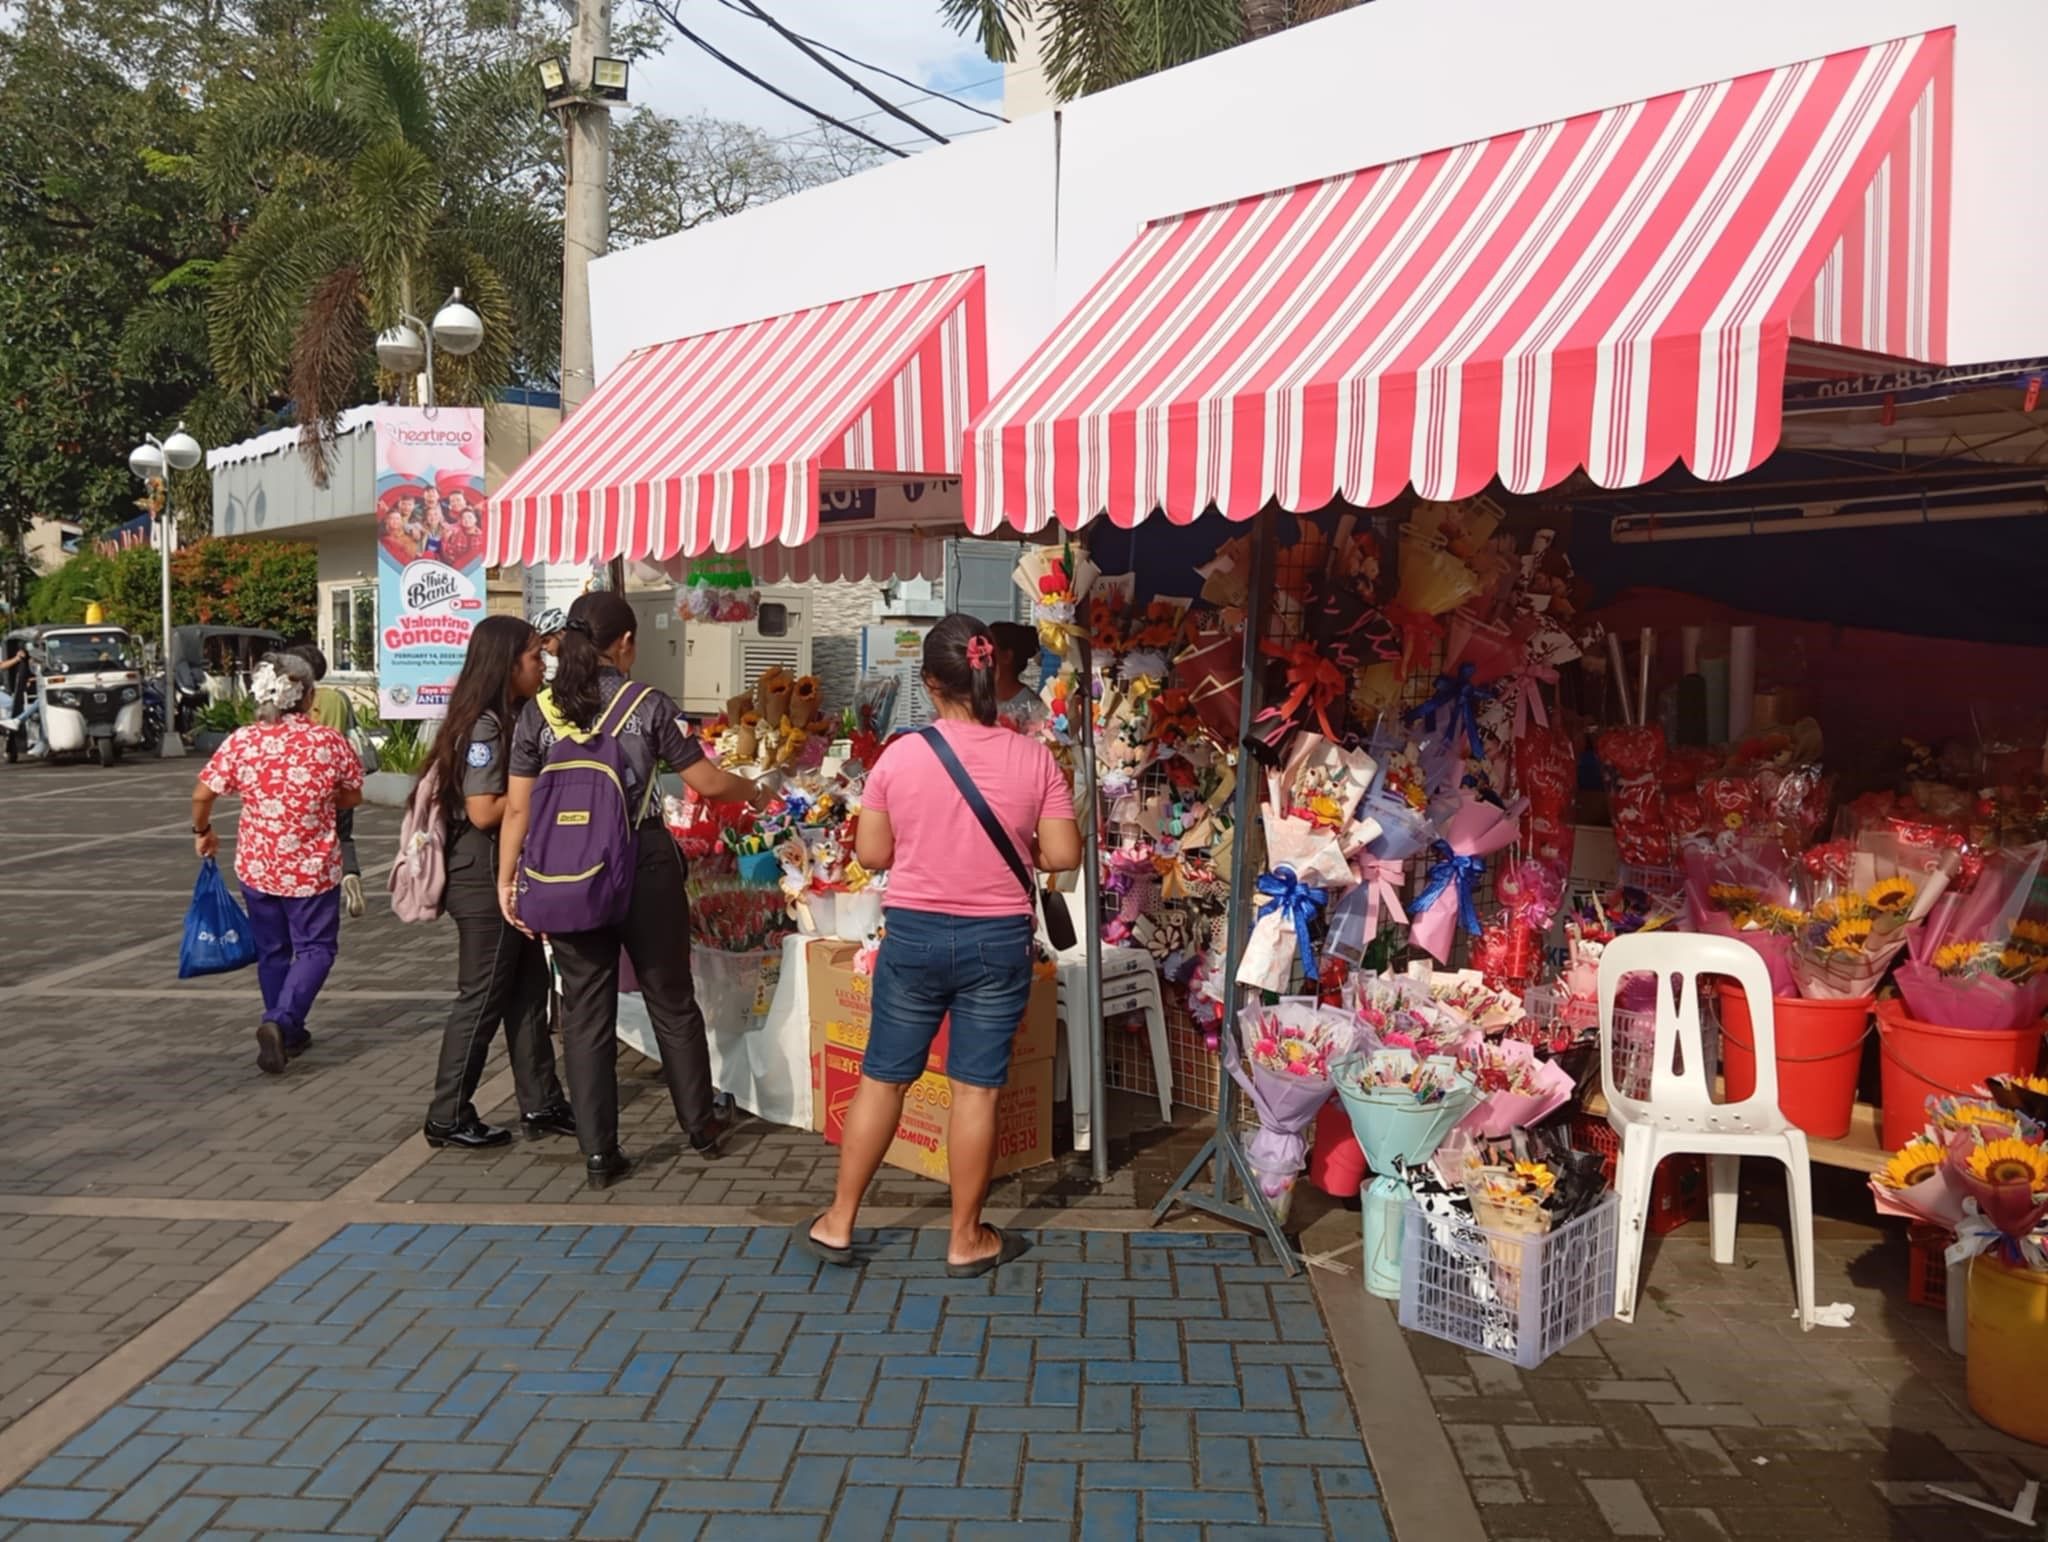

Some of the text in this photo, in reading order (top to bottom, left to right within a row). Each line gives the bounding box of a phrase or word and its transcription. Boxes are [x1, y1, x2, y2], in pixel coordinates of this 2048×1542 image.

[421, 570, 449, 588] This
[407, 576, 458, 609] Band
[400, 616, 470, 631] Valentine
[384, 628, 470, 650] Concer
